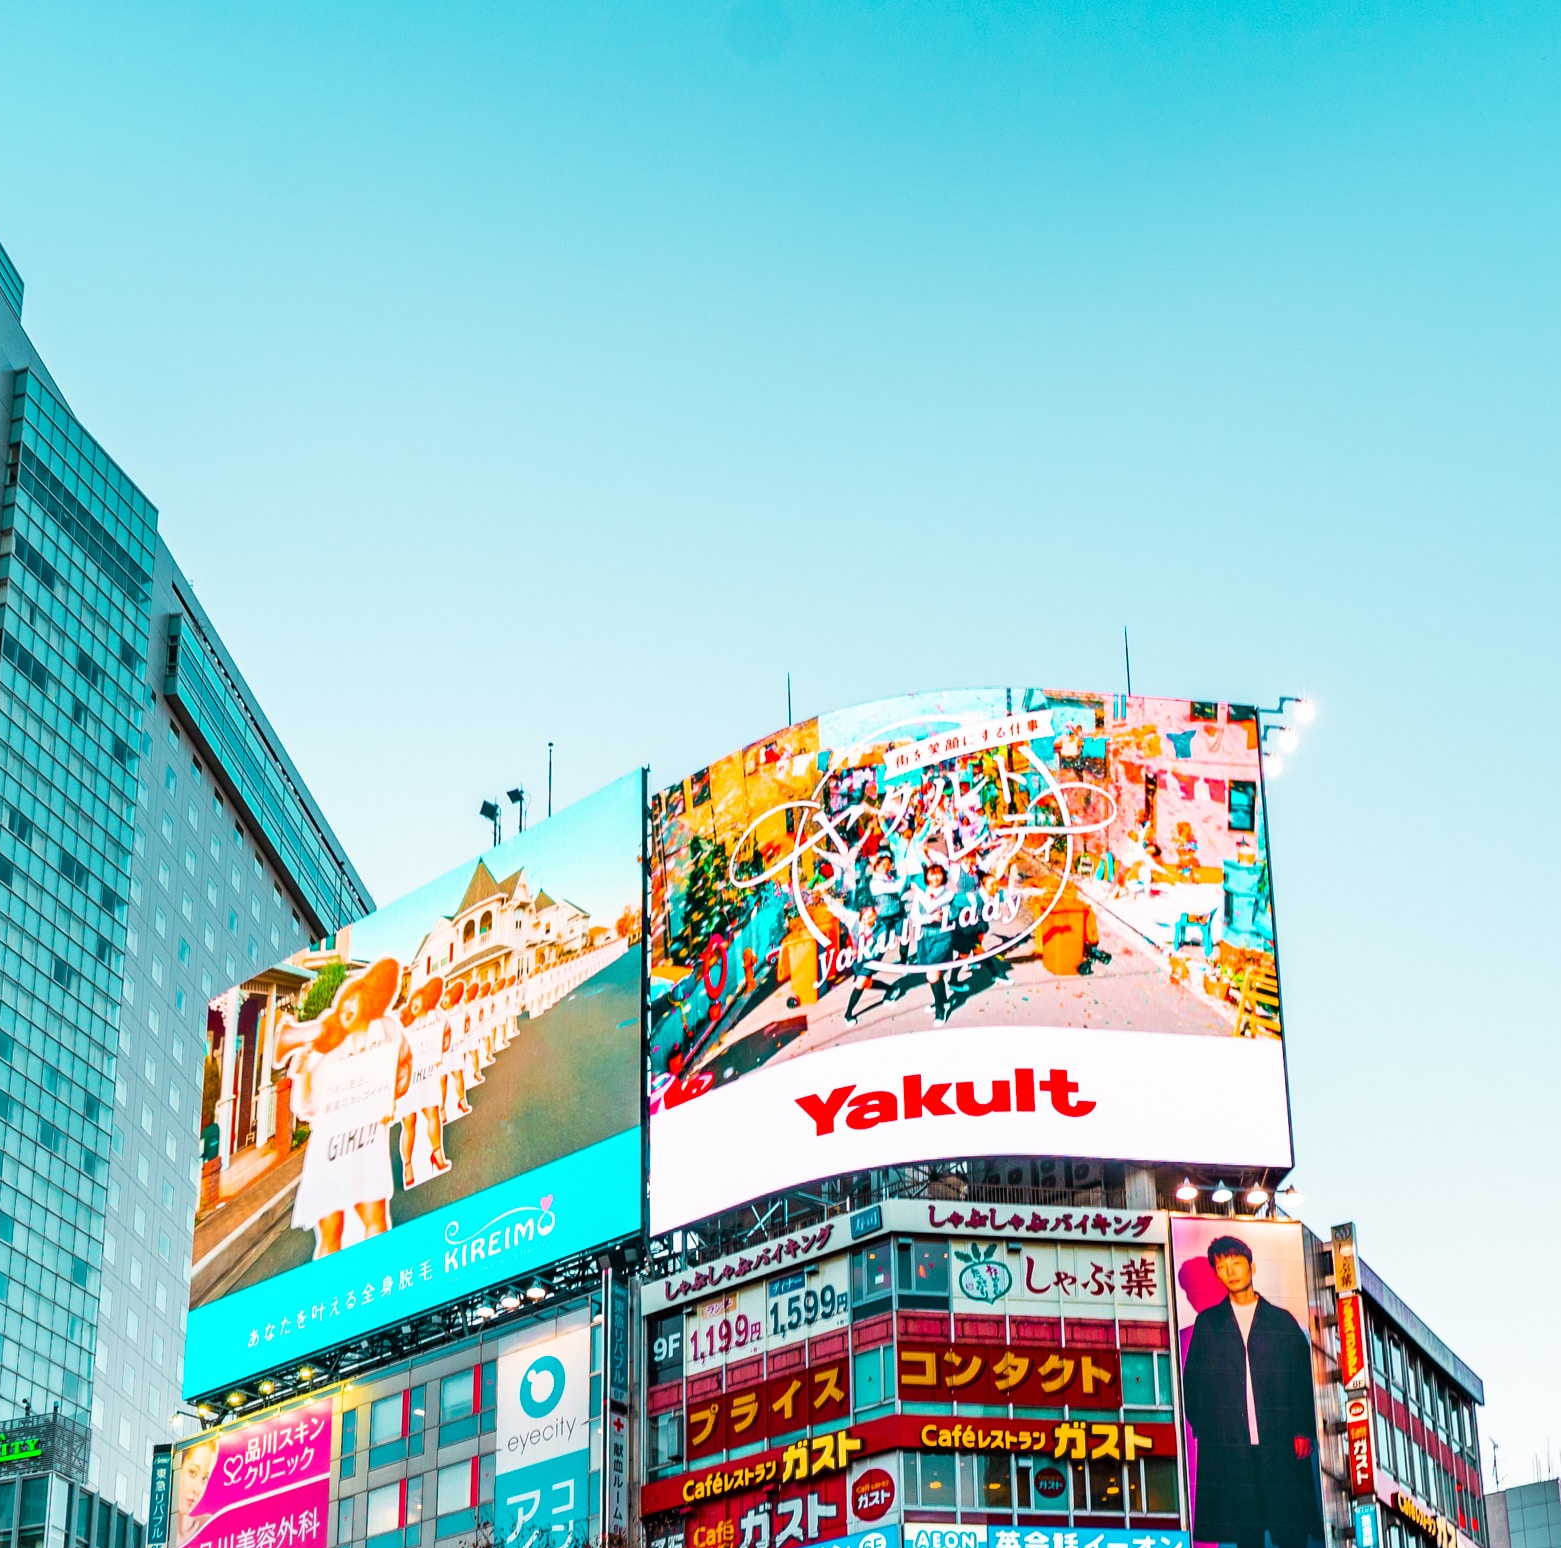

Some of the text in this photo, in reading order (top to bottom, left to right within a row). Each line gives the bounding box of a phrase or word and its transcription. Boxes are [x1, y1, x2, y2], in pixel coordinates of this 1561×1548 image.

[895, 718, 1039, 770] 街を笑顔にする仕事
[940, 892, 1022, 933] Lady
[795, 1068, 1096, 1137] Yakult
[444, 1207, 555, 1274] KIREIMO
[928, 1204, 1154, 1238] しゃぶしゃぶバイキング
[665, 1224, 834, 1300] しゃぶしゃぶバイキング
[1025, 1255, 1157, 1299] しゃぶ葉
[247, 1260, 435, 1348] あなたを叶える全身脱毛
[613, 1303, 625, 1383] 東急リバブル
[653, 1333, 681, 1362] 9F
[901, 1351, 1113, 1394] コンタクト
[690, 1368, 846, 1446] プライス
[244, 1417, 325, 1461] 品川スキン
[507, 1418, 576, 1454] eyecity
[782, 1431, 862, 1484] ガスト
[1054, 1421, 1153, 1461] ガスト
[244, 1447, 315, 1490] クリニック
[613, 1442, 624, 1520] 献血ルーム
[1353, 1441, 1370, 1485] ガスト
[152, 1468, 167, 1539] 東急リバブル
[857, 1492, 891, 1510] ガスト
[693, 1519, 734, 1548] Café
